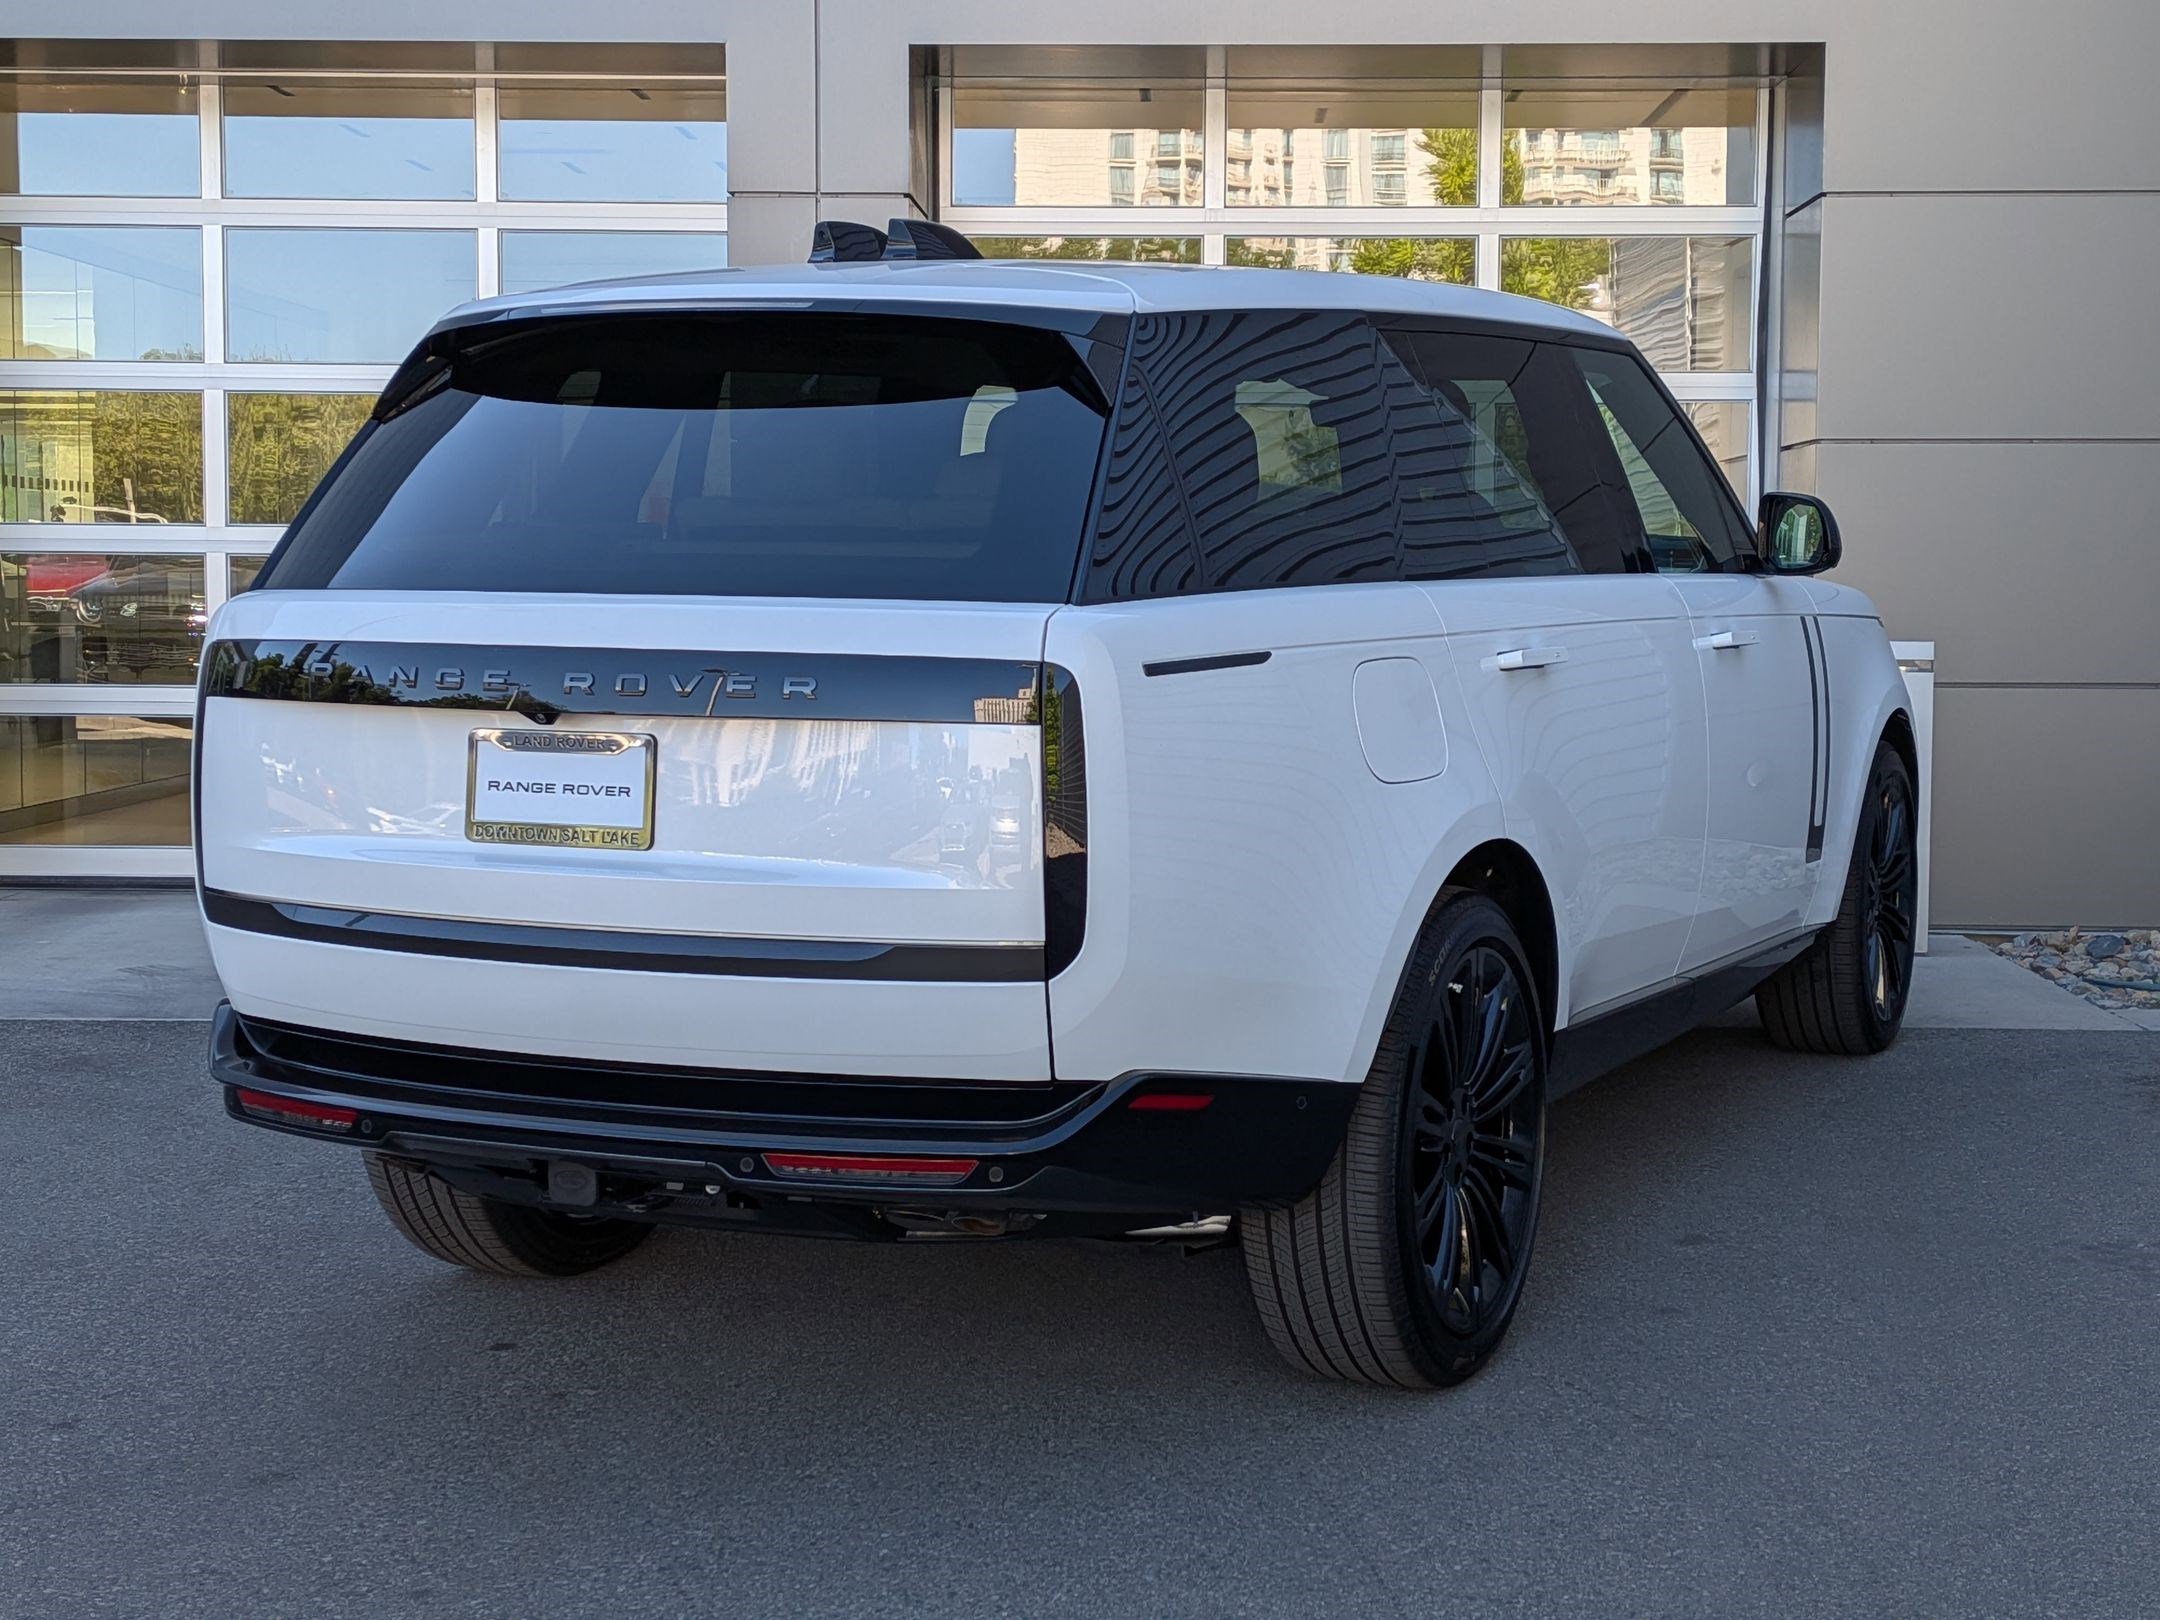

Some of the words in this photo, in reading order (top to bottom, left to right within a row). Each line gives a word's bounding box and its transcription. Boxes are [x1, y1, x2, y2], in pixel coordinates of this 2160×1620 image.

[309, 661, 512, 692] RANGE
[563, 671, 818, 700] ROVER
[513, 735, 551, 748] LAND
[556, 736, 606, 749] ROVER
[487, 780, 557, 794] RANGE
[562, 783, 632, 798] ROVER
[474, 824, 559, 842] DOWNTOWN
[561, 829, 598, 844] SALT
[601, 831, 641, 846] LAKE
